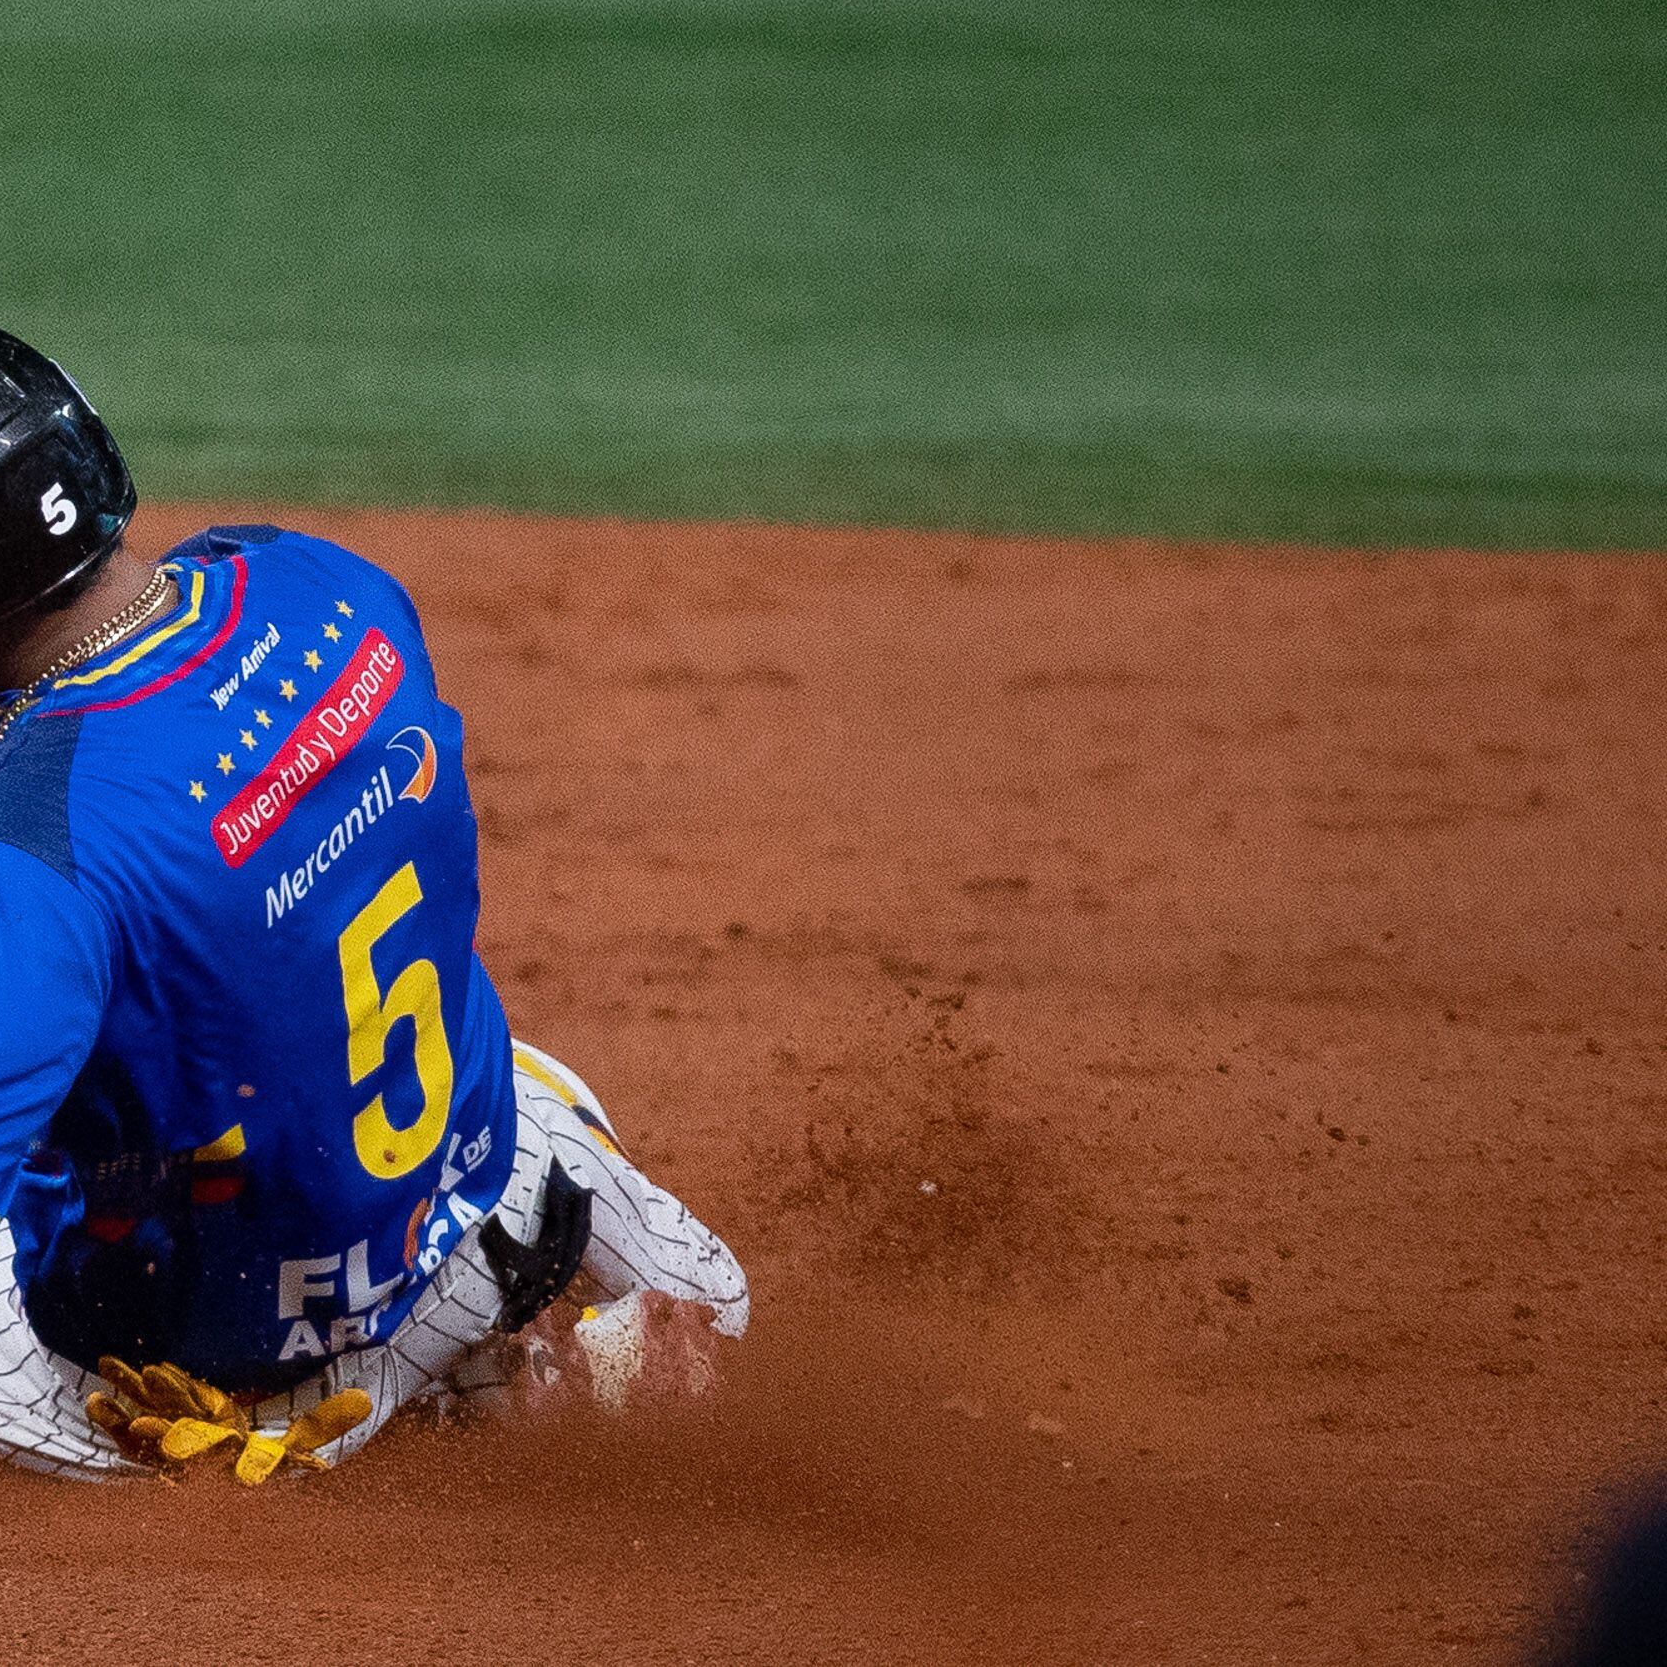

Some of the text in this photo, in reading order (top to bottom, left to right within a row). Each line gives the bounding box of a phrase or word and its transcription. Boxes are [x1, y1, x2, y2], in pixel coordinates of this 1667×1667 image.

[40, 482, 78, 536] 5
[240, 621, 281, 682] Arrival
[219, 641, 397, 855] Juventud y Deporte
[264, 765, 395, 929] Mercantil
[338, 860, 454, 1180] 5
